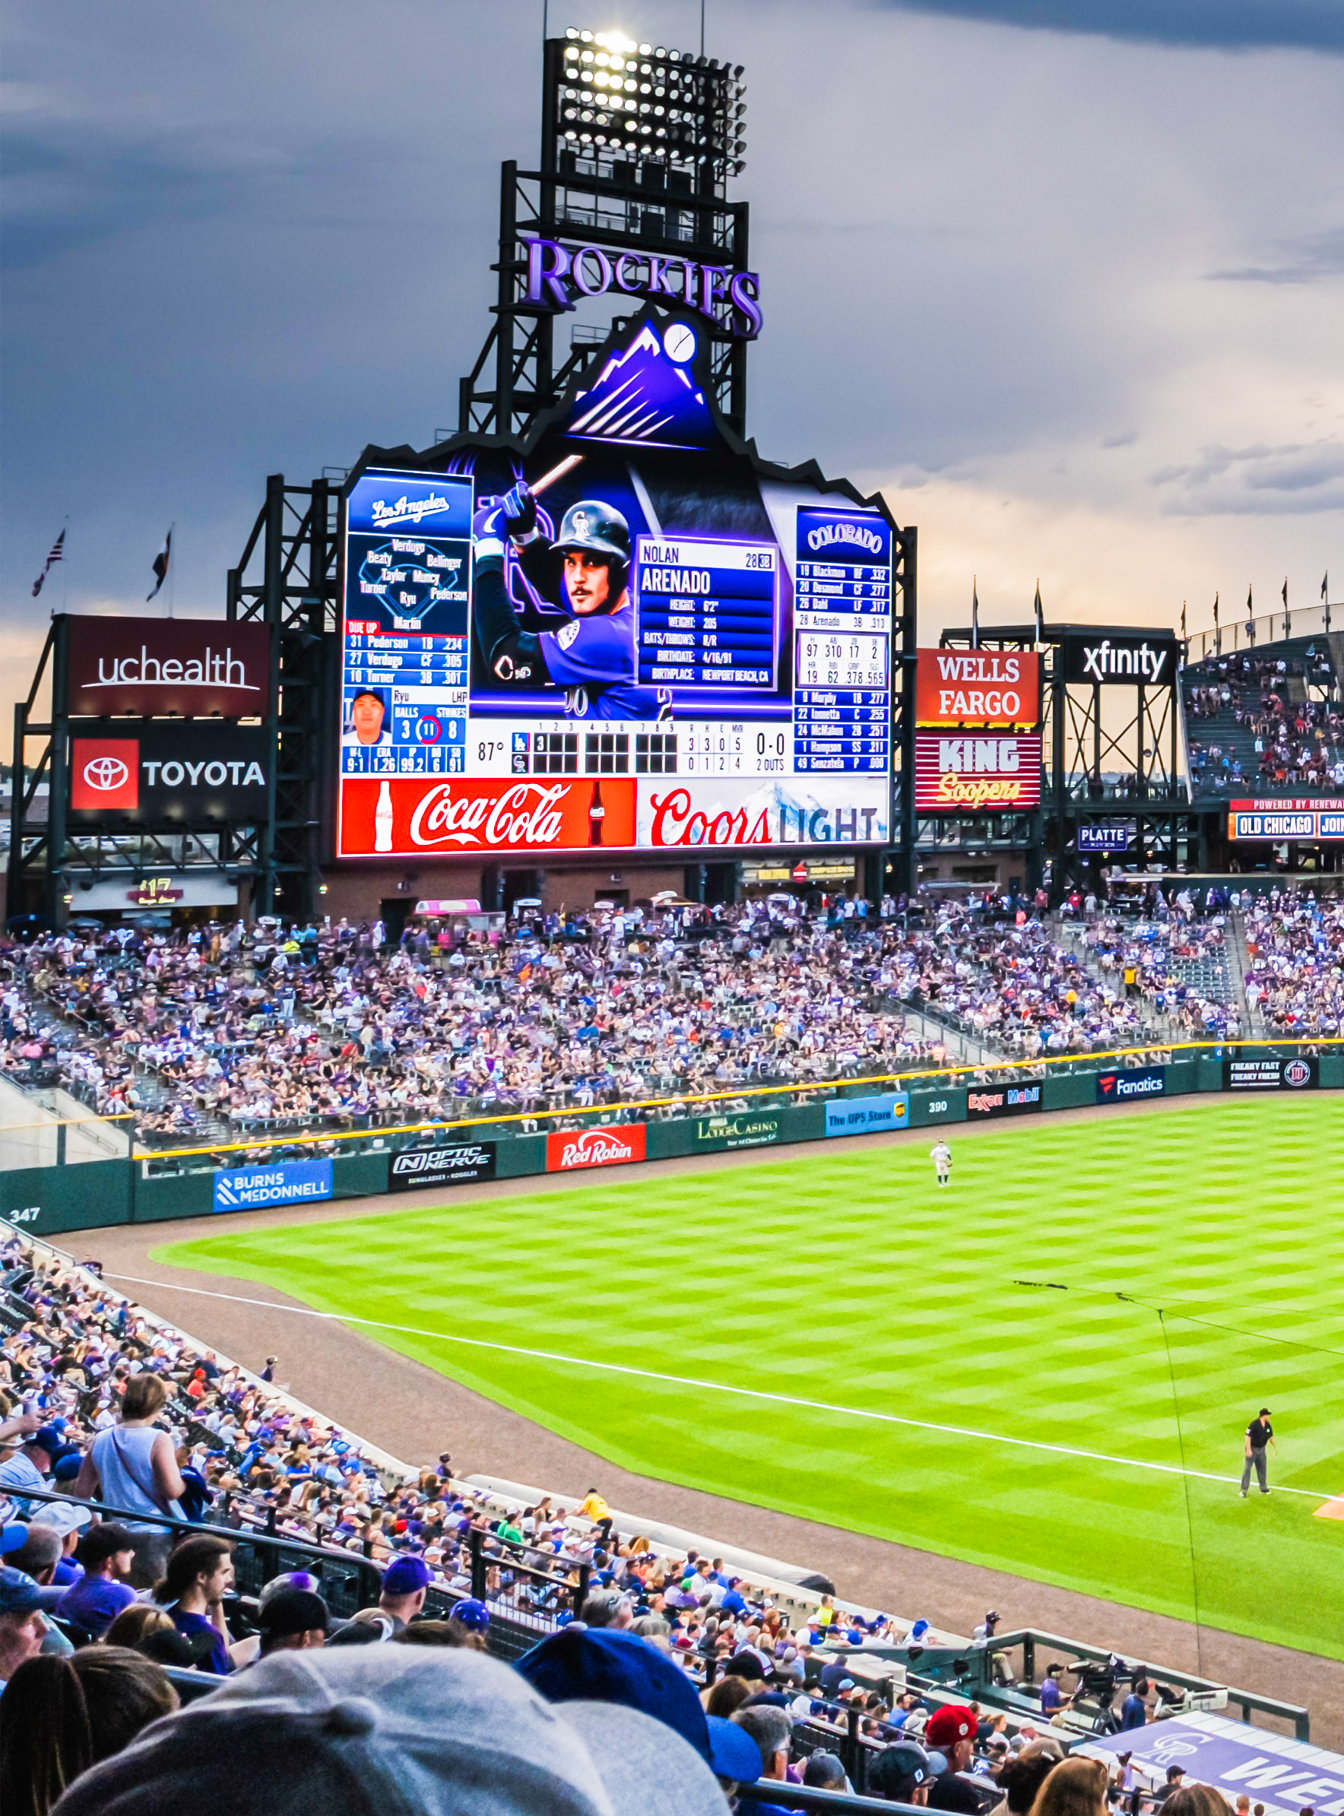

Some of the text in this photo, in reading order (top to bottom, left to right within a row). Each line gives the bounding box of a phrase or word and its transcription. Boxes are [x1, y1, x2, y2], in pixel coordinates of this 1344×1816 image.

[520, 237, 763, 338] ROCKIES
[391, 539, 425, 555] Verdugo
[807, 523, 884, 555] COLORADO
[367, 550, 392, 568] Beaty
[426, 553, 463, 570] Bellinger
[643, 545, 680, 564] NOLAN
[381, 568, 407, 583] Taylor
[412, 569, 440, 585] Muncy
[641, 568, 711, 595] ARENADO
[360, 581, 388, 595] Turner
[430, 586, 468, 601] Pederson
[399, 591, 417, 607] Ryu
[348, 622, 378, 634] DUE UP
[393, 617, 422, 630] Martin
[350, 636, 362, 648] 31
[367, 635, 409, 650] Pederson
[98, 645, 245, 686] uchealth
[937, 656, 1020, 682] WELLS
[1083, 640, 1167, 682] xfinity
[394, 706, 419, 718] BALLS
[939, 690, 1020, 716] FARGO
[436, 707, 466, 718] STRIKES
[478, 742, 504, 761] 87°
[939, 740, 1020, 772] KING
[142, 761, 265, 787] TOYOTA
[936, 772, 1021, 808] Soopers
[1253, 800, 1294, 810] POWERED
[1295, 799, 1307, 809] BY
[410, 783, 572, 846] Coca-Cola
[650, 788, 877, 846] Coors LIGHT
[1240, 816, 1312, 835] OLD CHICAGO
[1081, 829, 1124, 841] PLATTE
[1116, 1076, 1163, 1095] Fanatics
[928, 1100, 947, 1113] 390
[968, 1086, 1040, 1112] Exxon Mobil
[732, 1117, 778, 1135] CASINO
[828, 1109, 892, 1127] The UPS Store
[428, 1146, 482, 1161] OPTIC
[561, 1139, 632, 1167] Red Robin
[424, 1154, 492, 1171] NERVE
[234, 1172, 284, 1190] BURNS
[10, 1207, 41, 1223] 347
